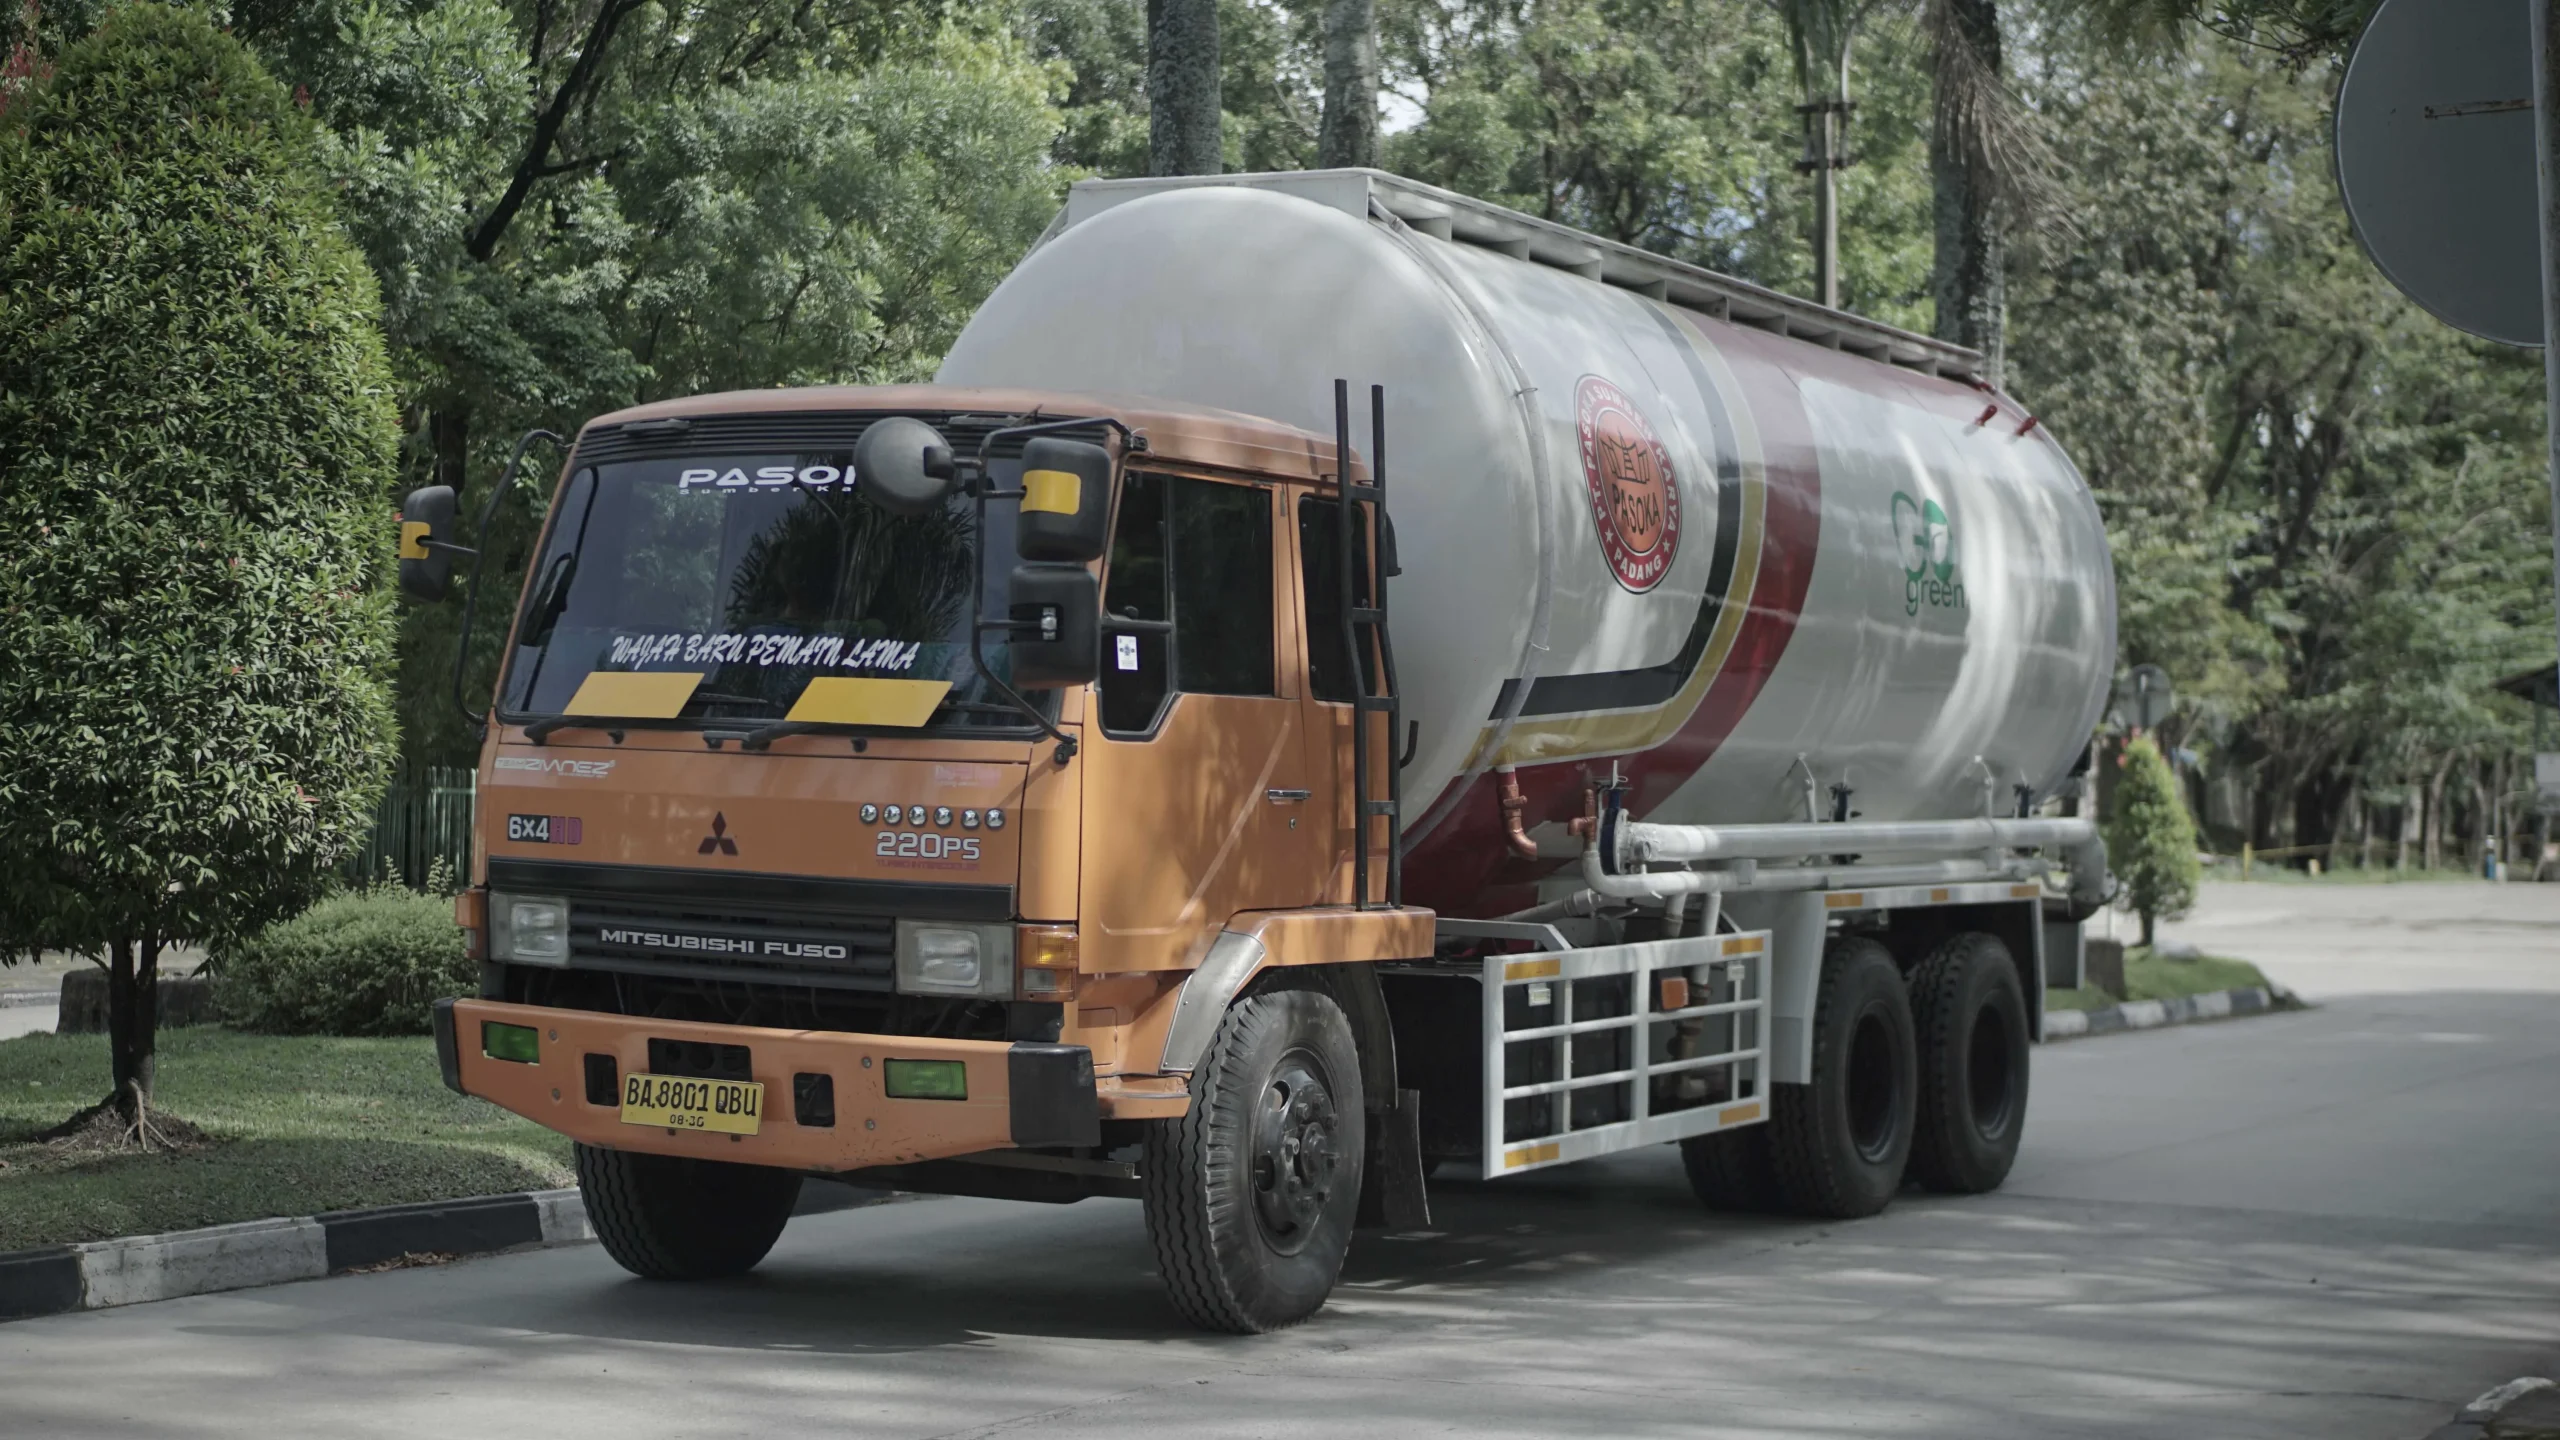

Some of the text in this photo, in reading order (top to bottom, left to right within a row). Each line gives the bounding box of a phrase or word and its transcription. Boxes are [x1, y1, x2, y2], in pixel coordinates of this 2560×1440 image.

[1655, 447, 1678, 532] KARYA
[1612, 483, 1661, 535] PASOKA
[1614, 547, 1662, 580] PADANG
[1905, 580, 1965, 617] green
[684, 633, 748, 664] BARU
[841, 638, 921, 671] LAMA
[876, 831, 981, 860] 220PS
[601, 929, 847, 959] MITSUBISHI FUSO
[715, 1085, 758, 1117] QBU
